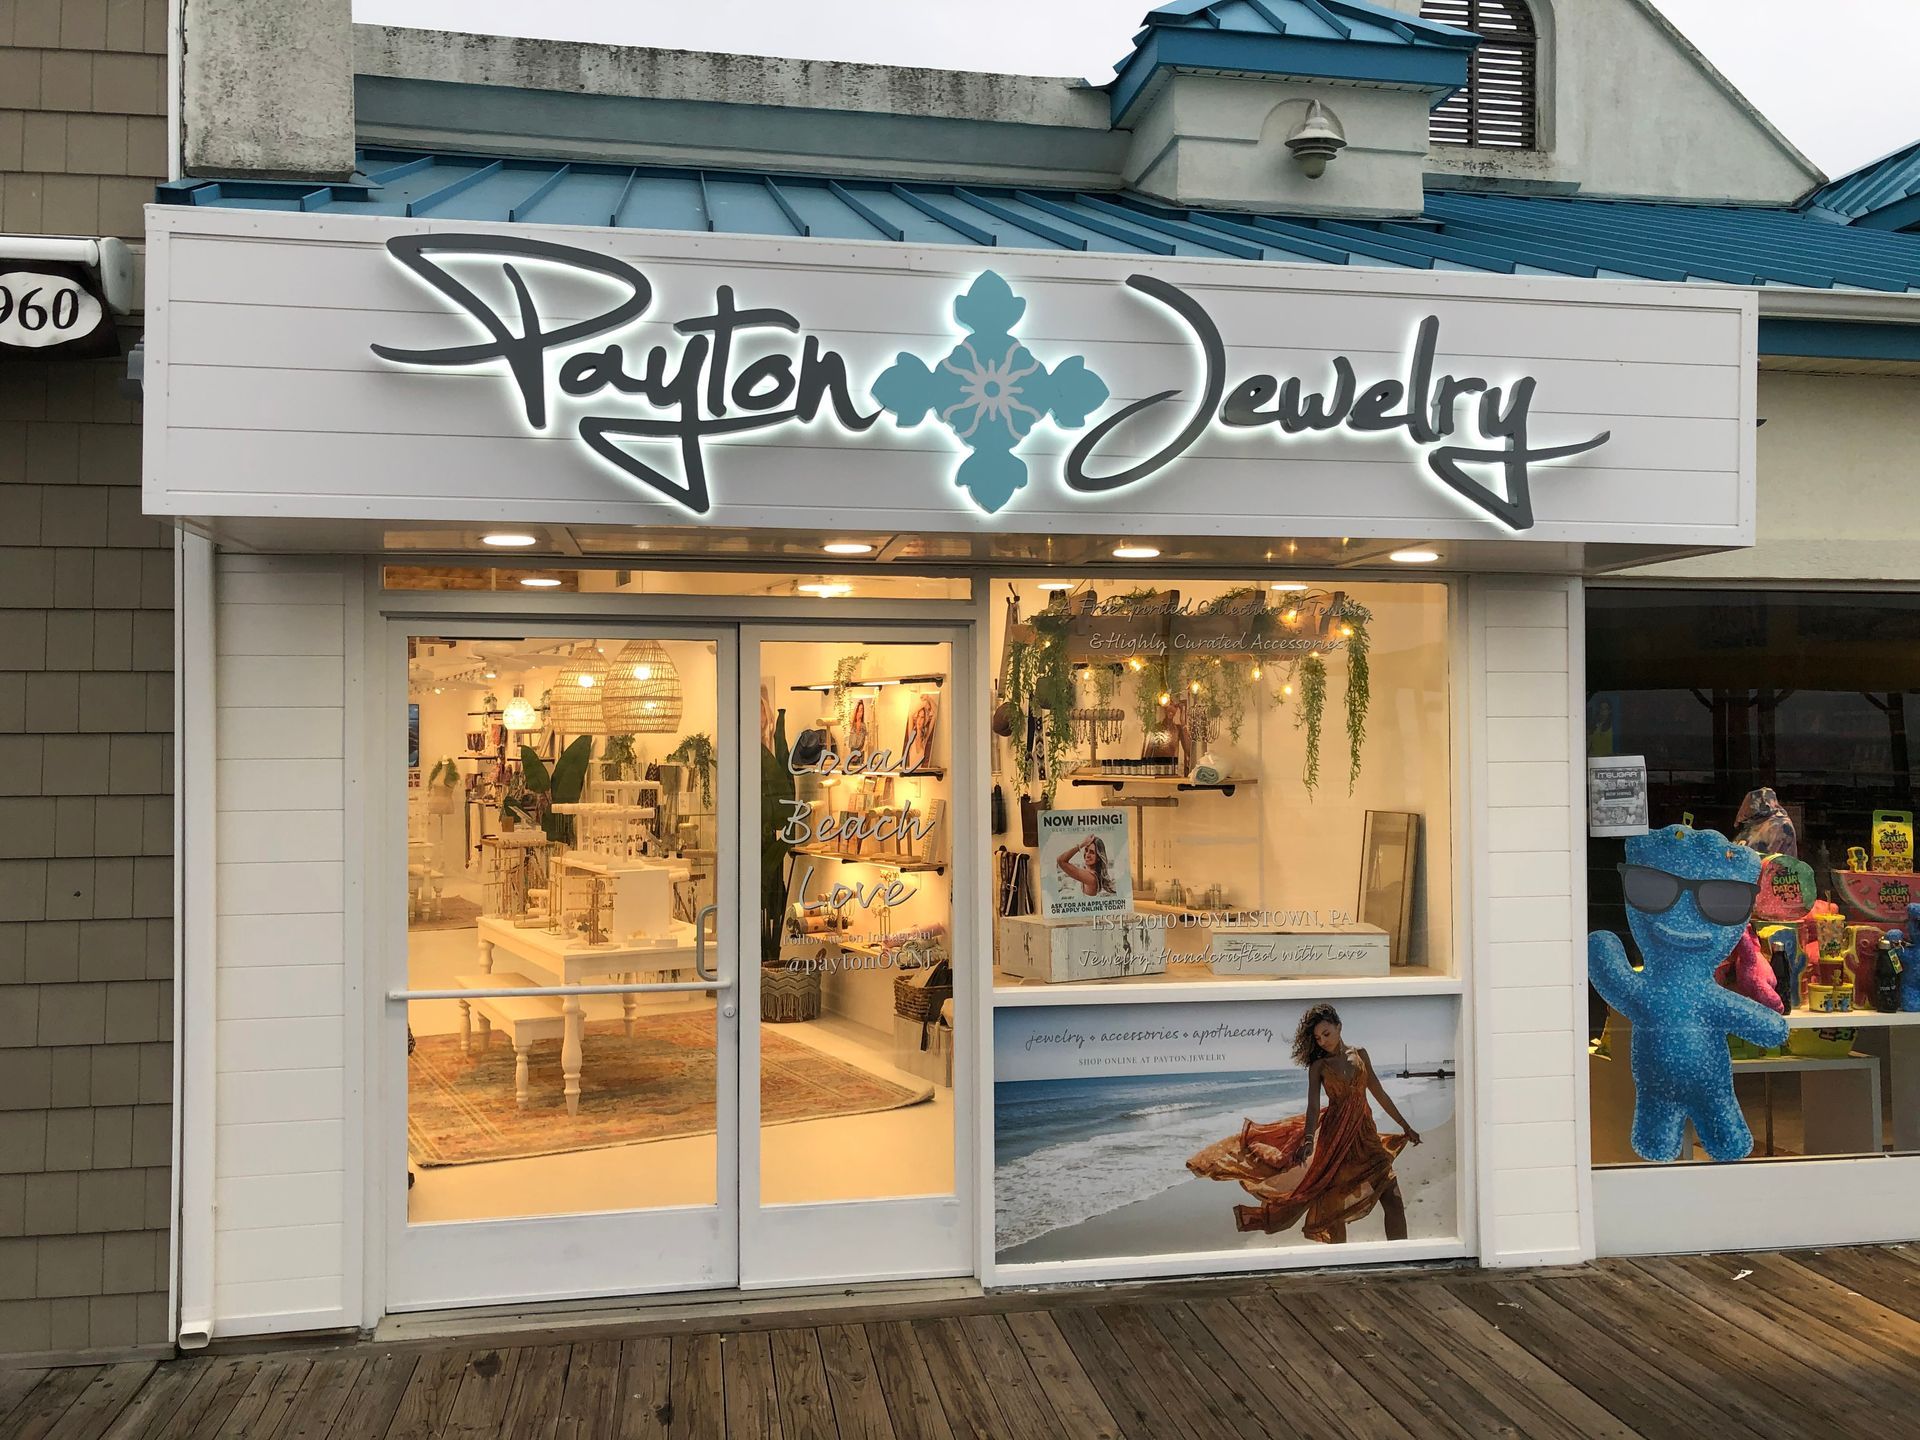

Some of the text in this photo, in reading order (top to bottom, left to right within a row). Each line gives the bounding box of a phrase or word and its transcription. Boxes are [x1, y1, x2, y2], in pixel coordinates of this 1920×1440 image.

[372, 233, 1612, 531] Payton Jewelry
[1174, 632, 1248, 651] Curated
[1250, 633, 1344, 650] Accessories
[787, 730, 926, 776] Local
[779, 799, 936, 844] Beach
[1043, 813, 1123, 828] NOW HIRING!
[798, 865, 918, 911] Love
[1773, 884, 1800, 895] PATCH
[1880, 887, 1908, 895] SOUR
[1088, 899, 1126, 907] APPLICATION
[1880, 895, 1910, 903] PATCH
[1135, 912, 1177, 930] 2010
[1183, 910, 1325, 929] DOYLESTOWN,
[1328, 909, 1354, 926] PA
[848, 934, 864, 945] on
[785, 948, 932, 976] @paytonOCNJ
[1080, 943, 1369, 973] Jewelry Handcrafted with Love
[1025, 1022, 1274, 1051] jewelry accessories apothecary
[1079, 1057, 1102, 1065] SHOP
[1104, 1056, 1137, 1064] ONLINE
[1141, 1056, 1150, 1064] AT
